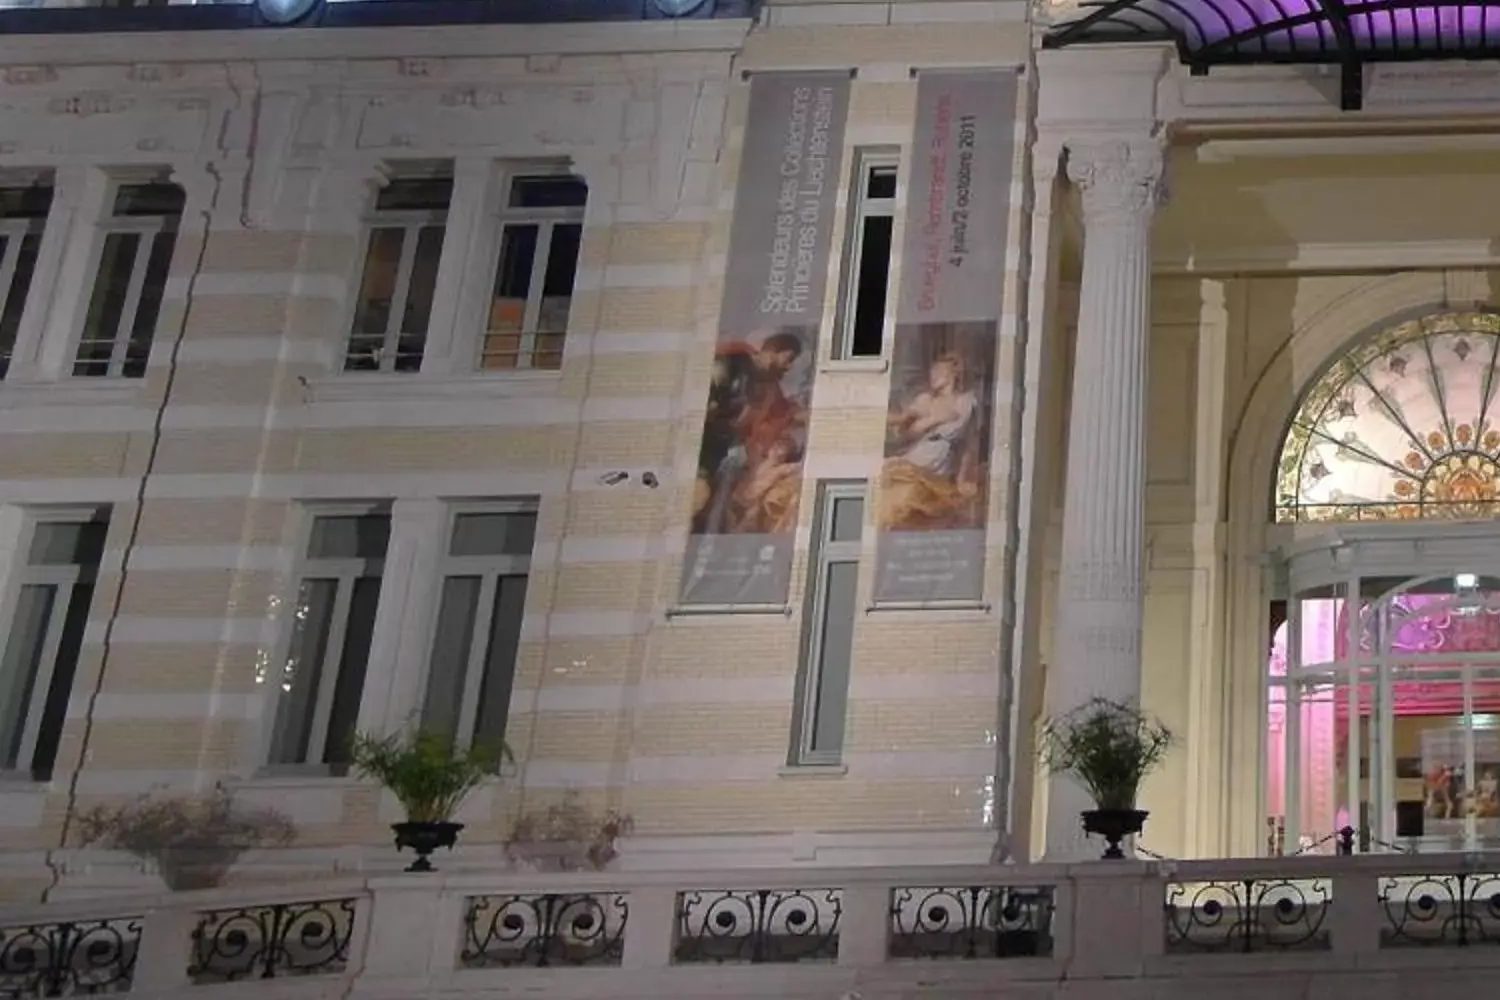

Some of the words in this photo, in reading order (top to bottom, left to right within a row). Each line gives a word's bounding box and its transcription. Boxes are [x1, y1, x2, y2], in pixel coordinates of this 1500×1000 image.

[781, 86, 811, 175] Collections
[800, 86, 834, 195] Liechtenstein
[958, 114, 976, 148] 2011
[778, 179, 798, 211] des
[956, 150, 972, 207] octobre
[801, 199, 819, 222] du
[950, 210, 969, 253] juin/2
[762, 214, 793, 312] Splendeurs
[948, 256, 963, 268] 4
